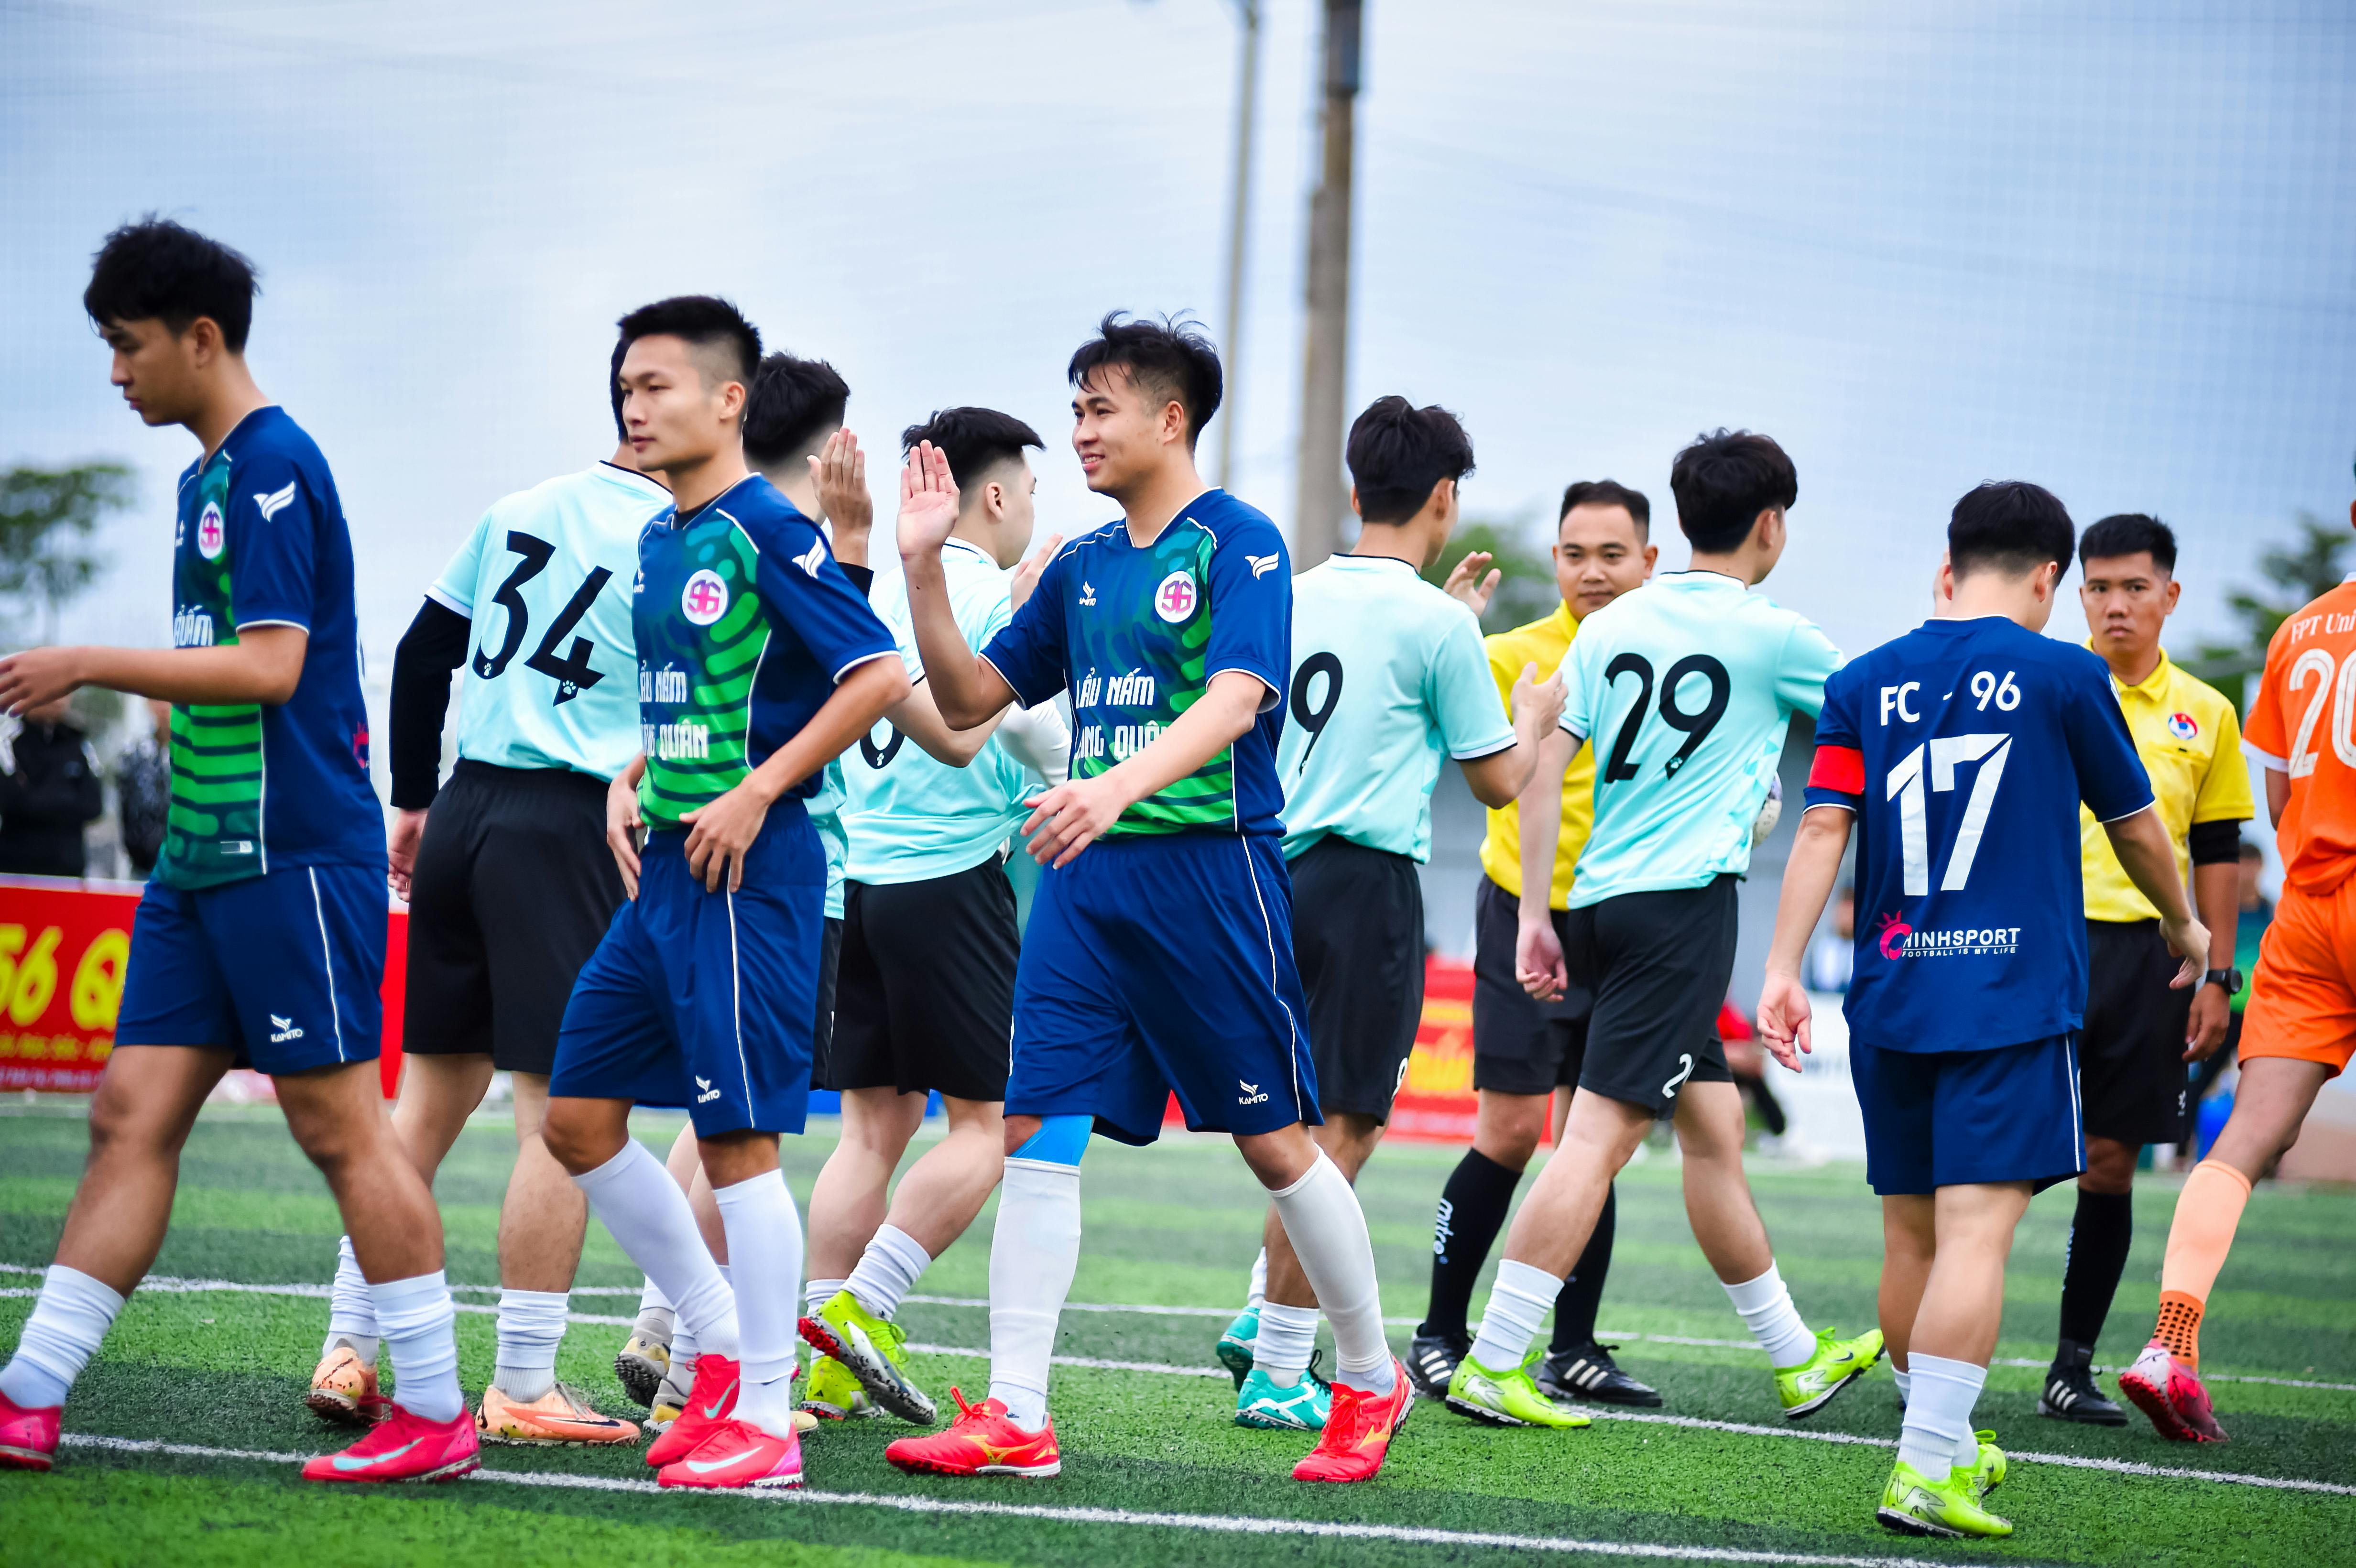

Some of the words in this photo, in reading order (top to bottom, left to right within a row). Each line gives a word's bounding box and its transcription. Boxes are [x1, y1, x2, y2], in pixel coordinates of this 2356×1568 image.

[472, 530, 614, 707] 34
[2291, 614, 2322, 644] FPT
[655, 662, 687, 703] NẤM
[1106, 667, 1155, 706] NẤM
[1880, 681, 1920, 726] FC
[1971, 671, 2021, 711] 96
[1290, 652, 1343, 778] 9
[1604, 653, 1731, 784] 29
[659, 718, 708, 761] QUÂN
[1113, 720, 1168, 760] QUÂ
[1887, 733, 2012, 896] 17
[1902, 947, 1953, 958] FOOTBALL
[1959, 947, 1968, 955] IS
[1974, 947, 1988, 955] MY
[1994, 947, 2016, 955] LIFE
[271, 1028, 303, 1043] KAMITO
[1662, 1053, 1696, 1099] 2
[1239, 1093, 1268, 1105] KAMITO
[1433, 1198, 1454, 1254] mitre
